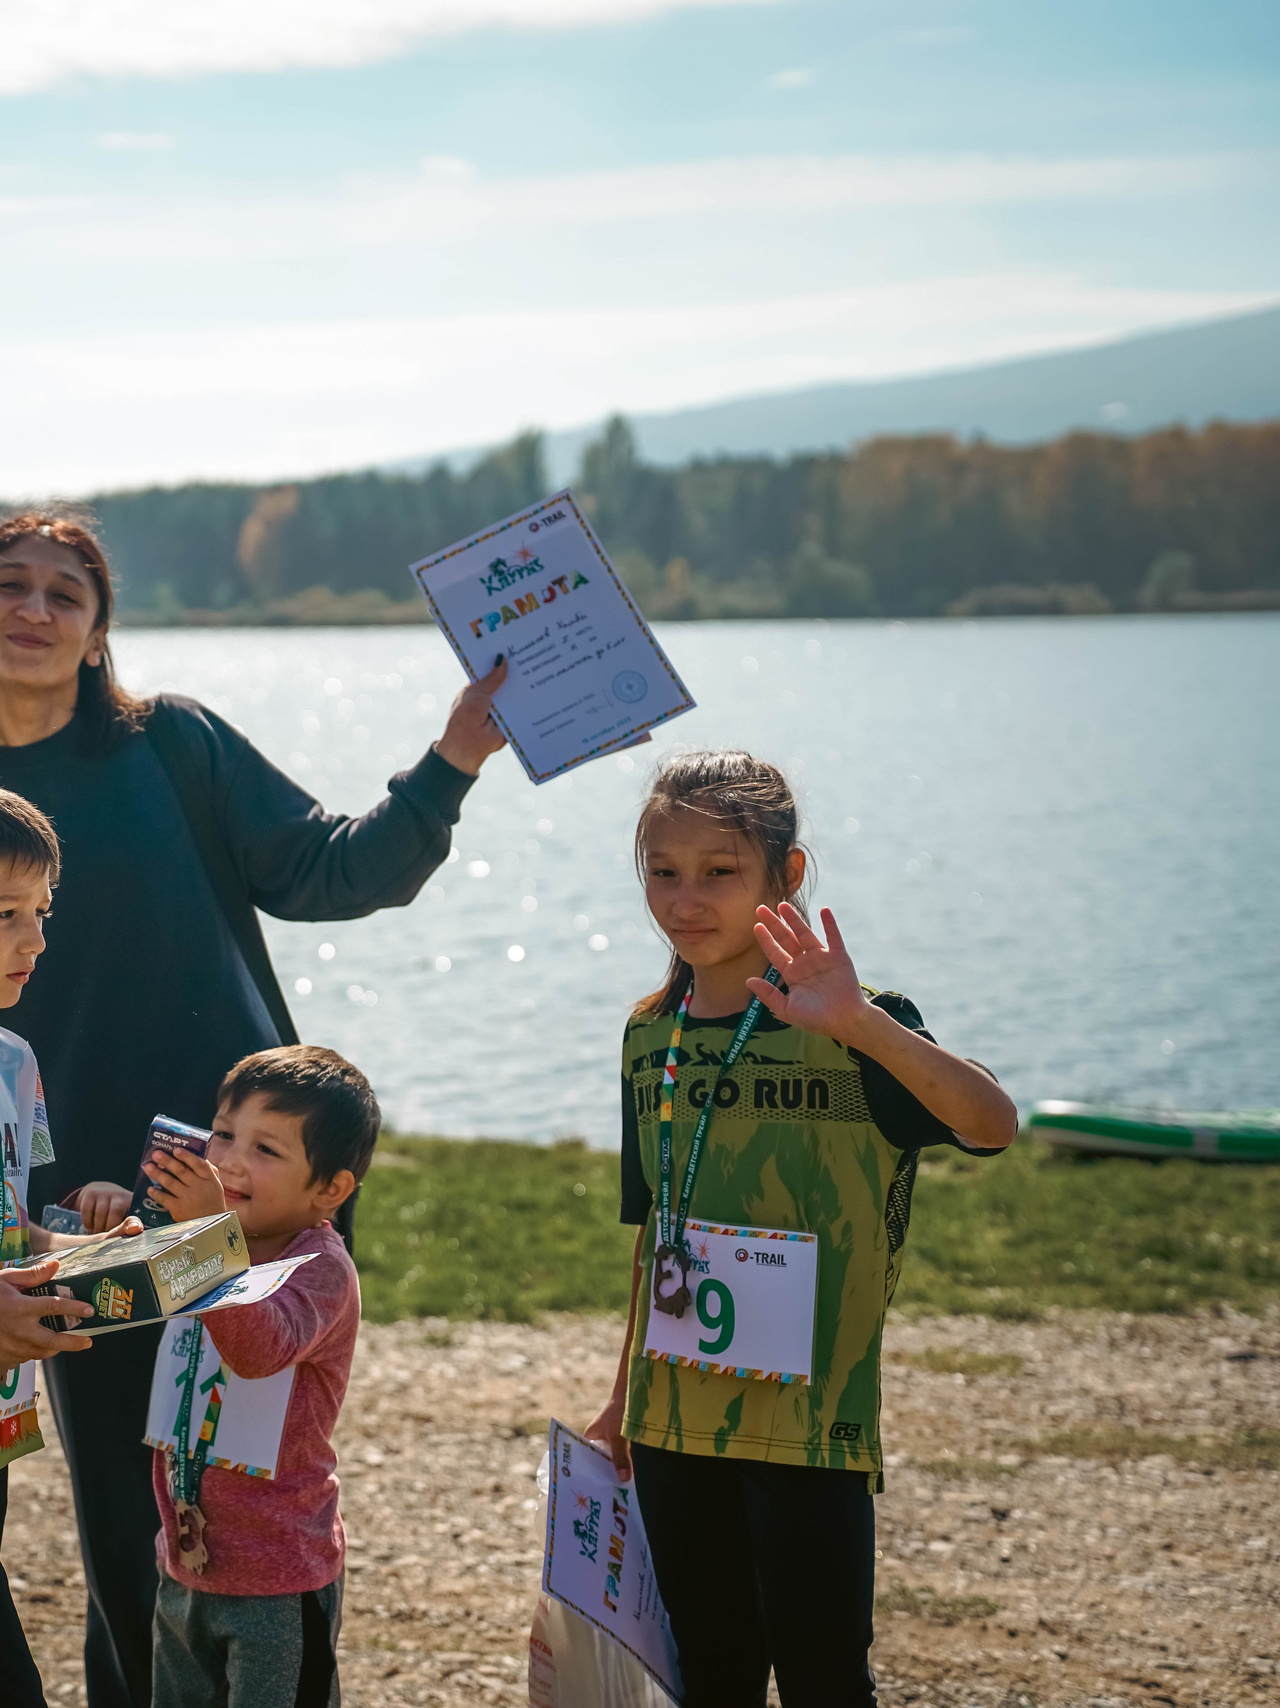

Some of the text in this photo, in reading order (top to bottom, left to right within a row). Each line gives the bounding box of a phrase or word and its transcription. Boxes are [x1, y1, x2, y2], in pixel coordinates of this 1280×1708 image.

[528, 510, 566, 533] O-TRAIL
[469, 569, 590, 639] ГРАМОТА
[736, 1008, 758, 1042] ДЕТСКИЙ
[726, 1040, 742, 1064] ТРЕЙЛ
[688, 1078, 741, 1109] GO
[754, 1078, 830, 1110] RUN
[153, 1131, 189, 1147] СТАРТ
[682, 1114, 707, 1198] Karras ДЕТСКИЙ ТРЕЙЛ
[661, 1181, 670, 1206] ТРЕЙЛ
[735, 1248, 787, 1267] O-TRAIL
[98, 1277, 111, 1320] СКЕЛЕТ
[696, 1278, 735, 1355] 9
[603, 1487, 629, 1614] ГРАМОТА
